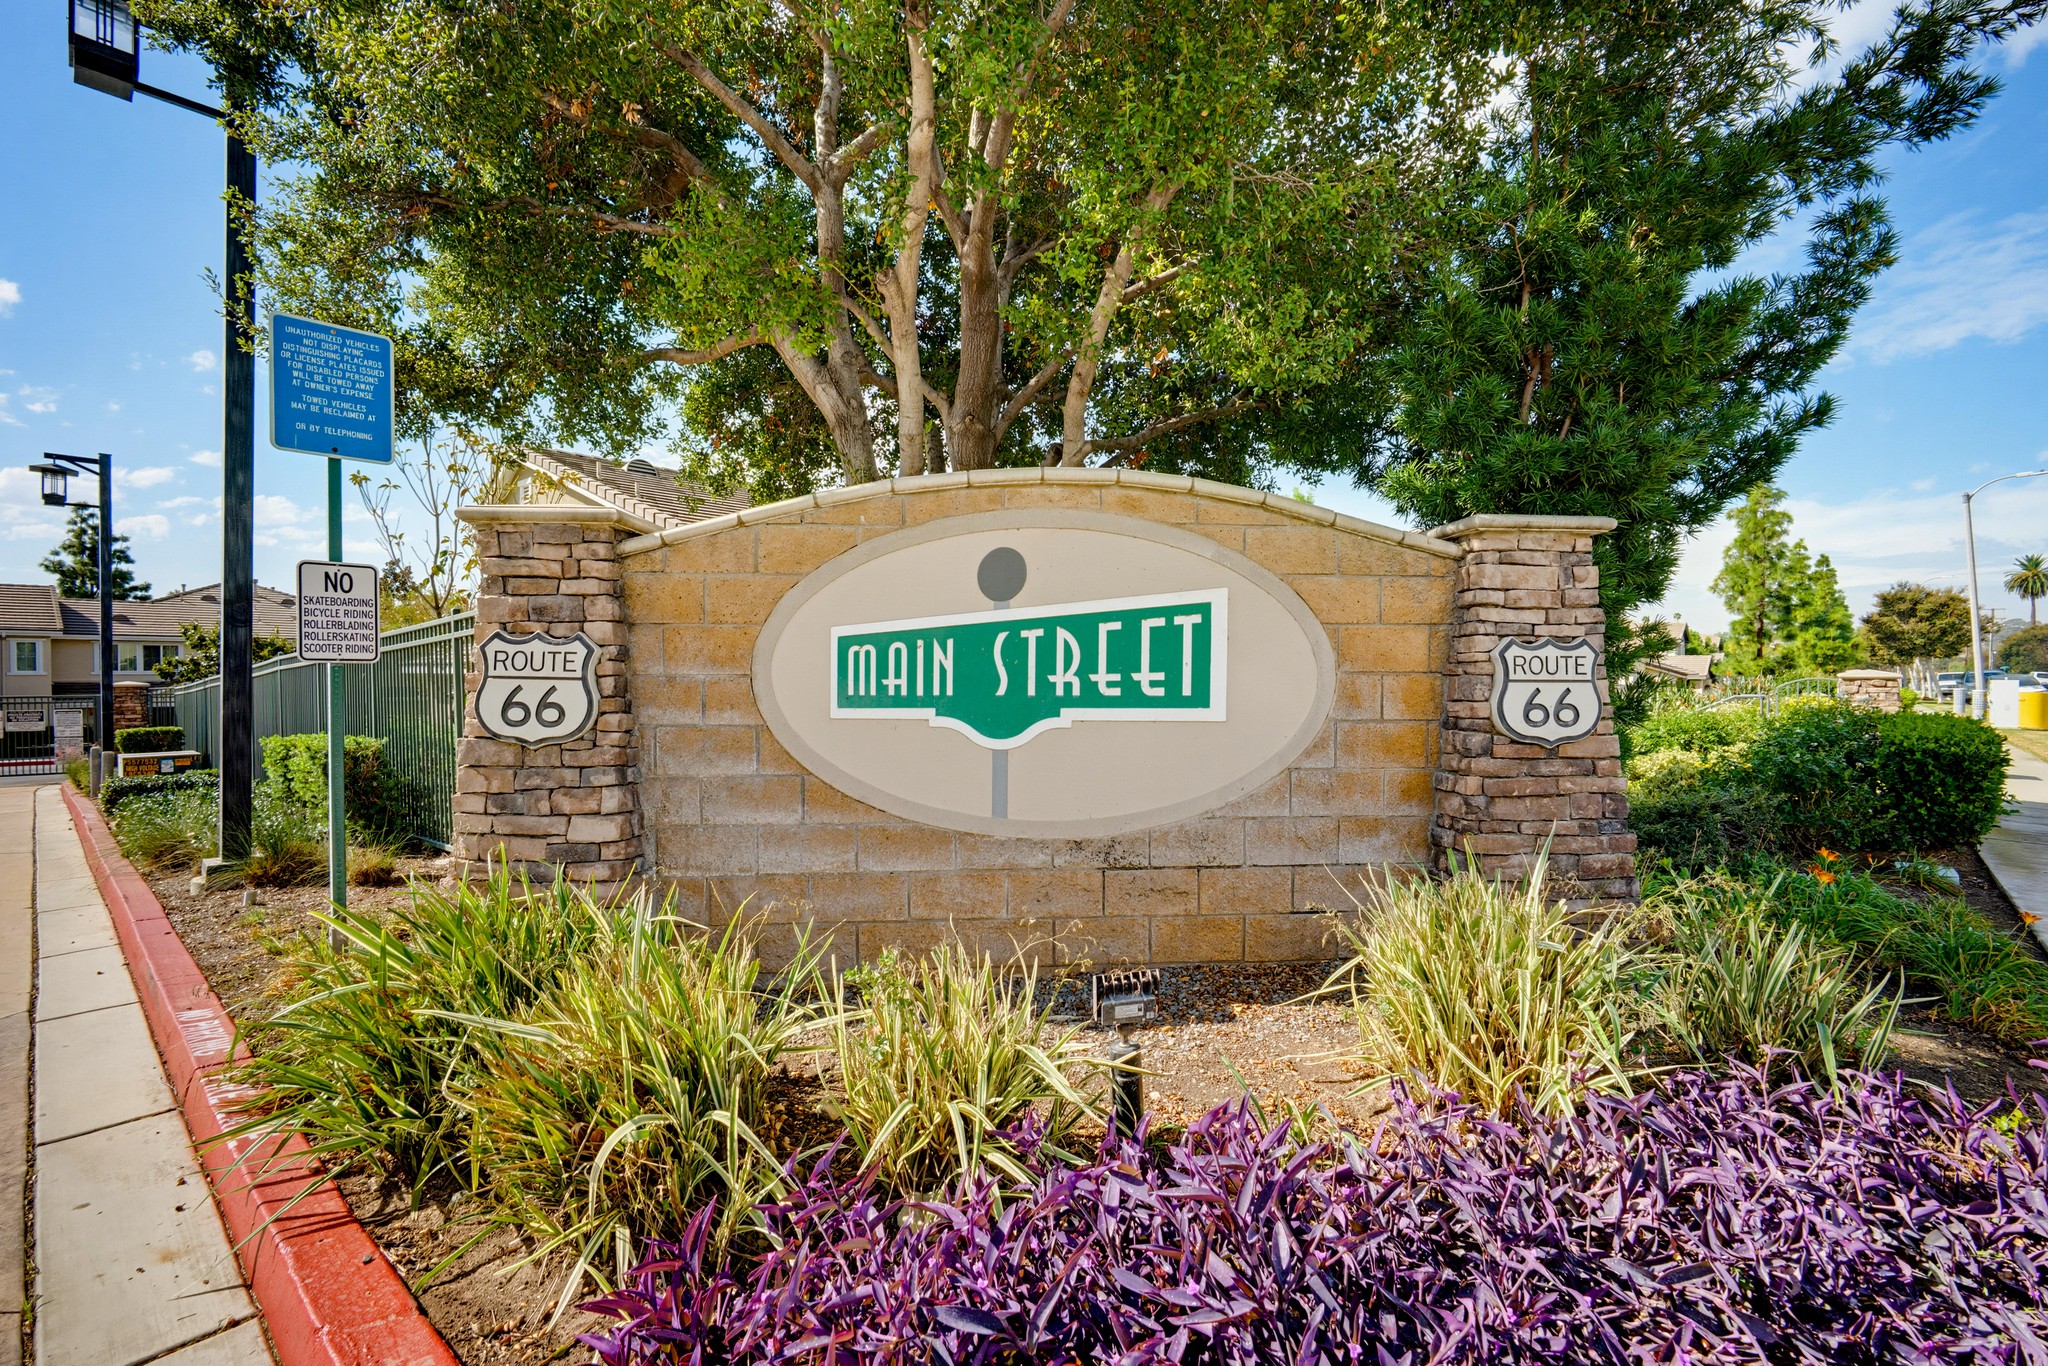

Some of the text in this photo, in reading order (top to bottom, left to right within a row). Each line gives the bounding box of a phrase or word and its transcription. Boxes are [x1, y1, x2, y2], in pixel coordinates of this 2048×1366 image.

[285, 326, 380, 352] UNAUTHORIZED VEHICLES
[303, 338, 364, 357] NOT DISPLAYING
[283, 342, 382, 369] DISTINGUISHING PLACARDS
[295, 353, 325, 366] LICENSE
[329, 360, 356, 372] PLATES
[360, 367, 385, 377] ISSUED
[288, 360, 379, 385] FOR DISABLED PERSONS
[292, 370, 310, 380] WILL
[327, 376, 352, 388] TOWED
[355, 381, 375, 391] AWAY
[292, 379, 301, 387] AT
[304, 381, 338, 393] OWNER'S
[291, 401, 376, 422] MAY BE RECLAIMED AT
[302, 394, 366, 412] TOWED VEHICLES
[296, 422, 373, 440] OR BY TELEPHONING
[324, 571, 353, 594] NO
[303, 595, 374, 608] SKATEBOARDING
[303, 607, 374, 619] BICYCLE RIDING
[303, 619, 374, 631] ROLLERBLADING
[303, 631, 374, 642] ROLLERSKATING
[303, 643, 374, 654] SCOOTER RIDING
[847, 613, 1203, 698] MAIN STREET
[493, 650, 578, 672] ROUTE
[1513, 655, 1588, 675] ROUTE
[501, 684, 566, 728] 66
[1523, 687, 1580, 728] 66
[175, 1008, 215, 1021] NO
